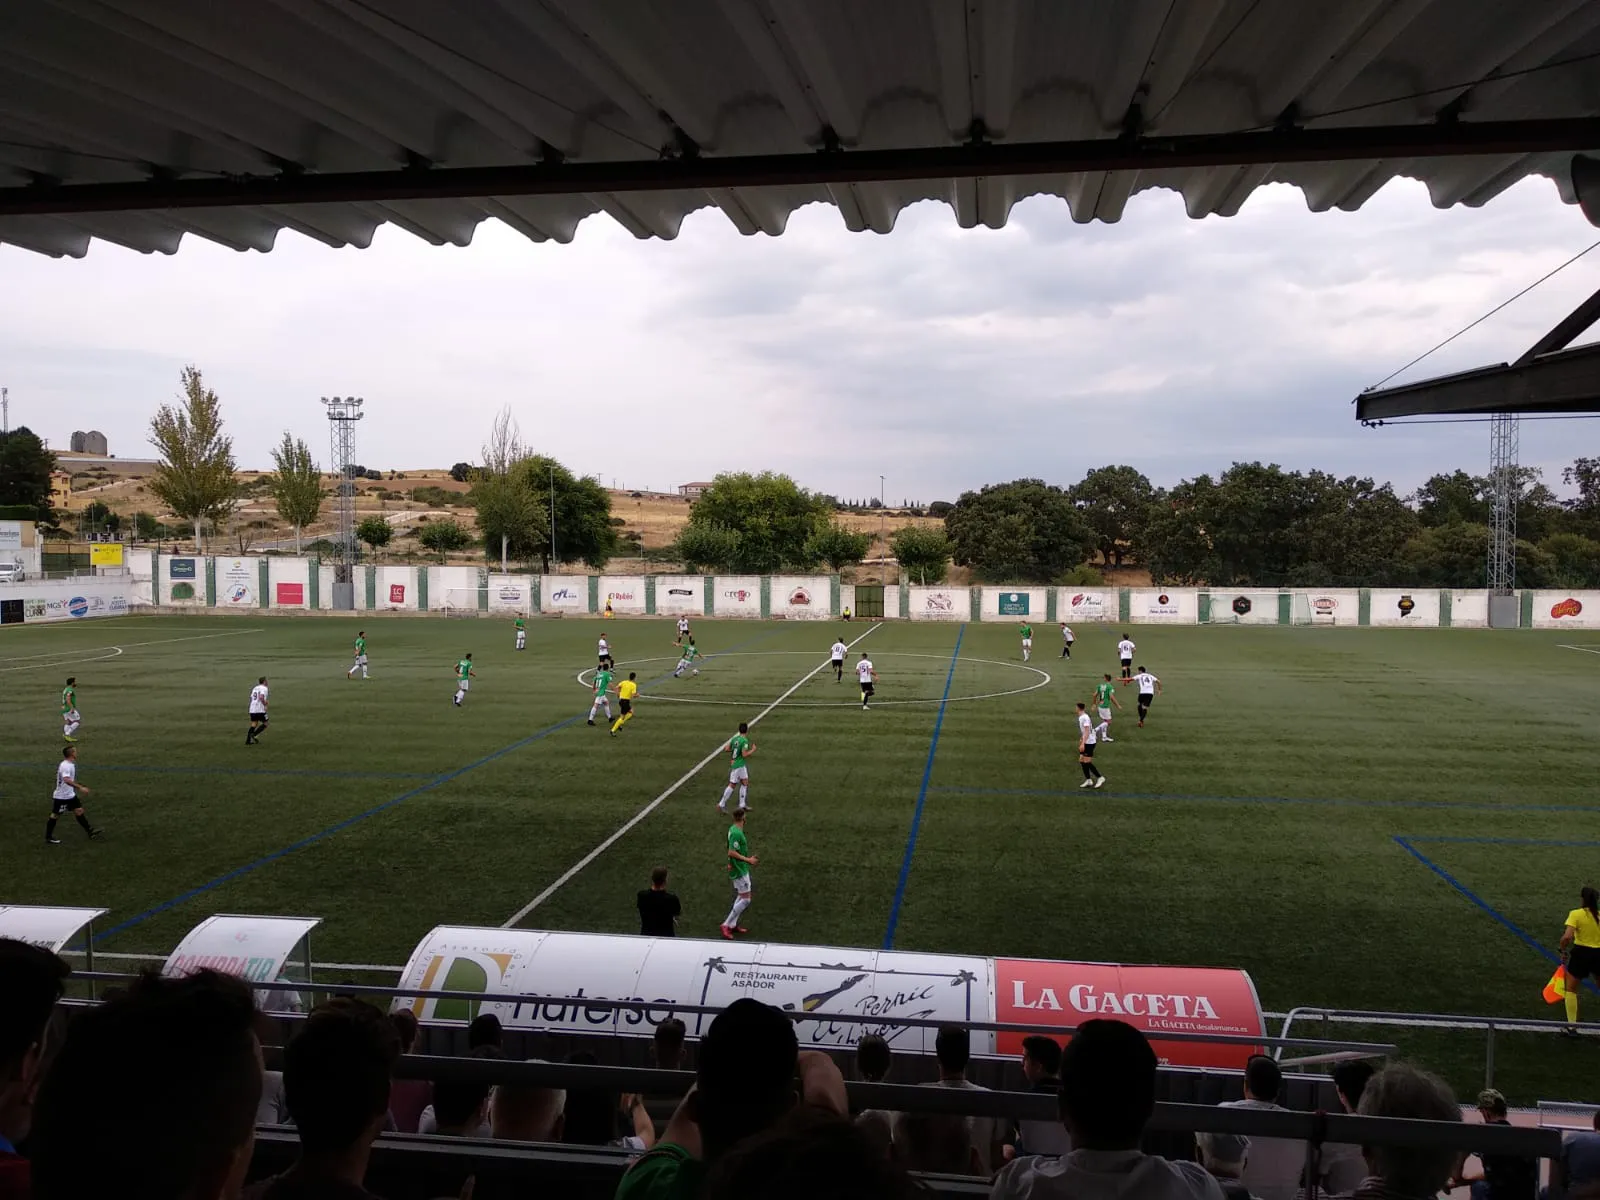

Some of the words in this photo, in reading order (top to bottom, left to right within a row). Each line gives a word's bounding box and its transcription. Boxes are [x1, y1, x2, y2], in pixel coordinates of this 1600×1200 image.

[46, 602, 61, 610] MGS
[595, 677, 602, 688] 11
[733, 971, 808, 982] RESTAURANTE
[731, 980, 775, 990] ASADOR
[1069, 983, 1220, 1020] GACETA
